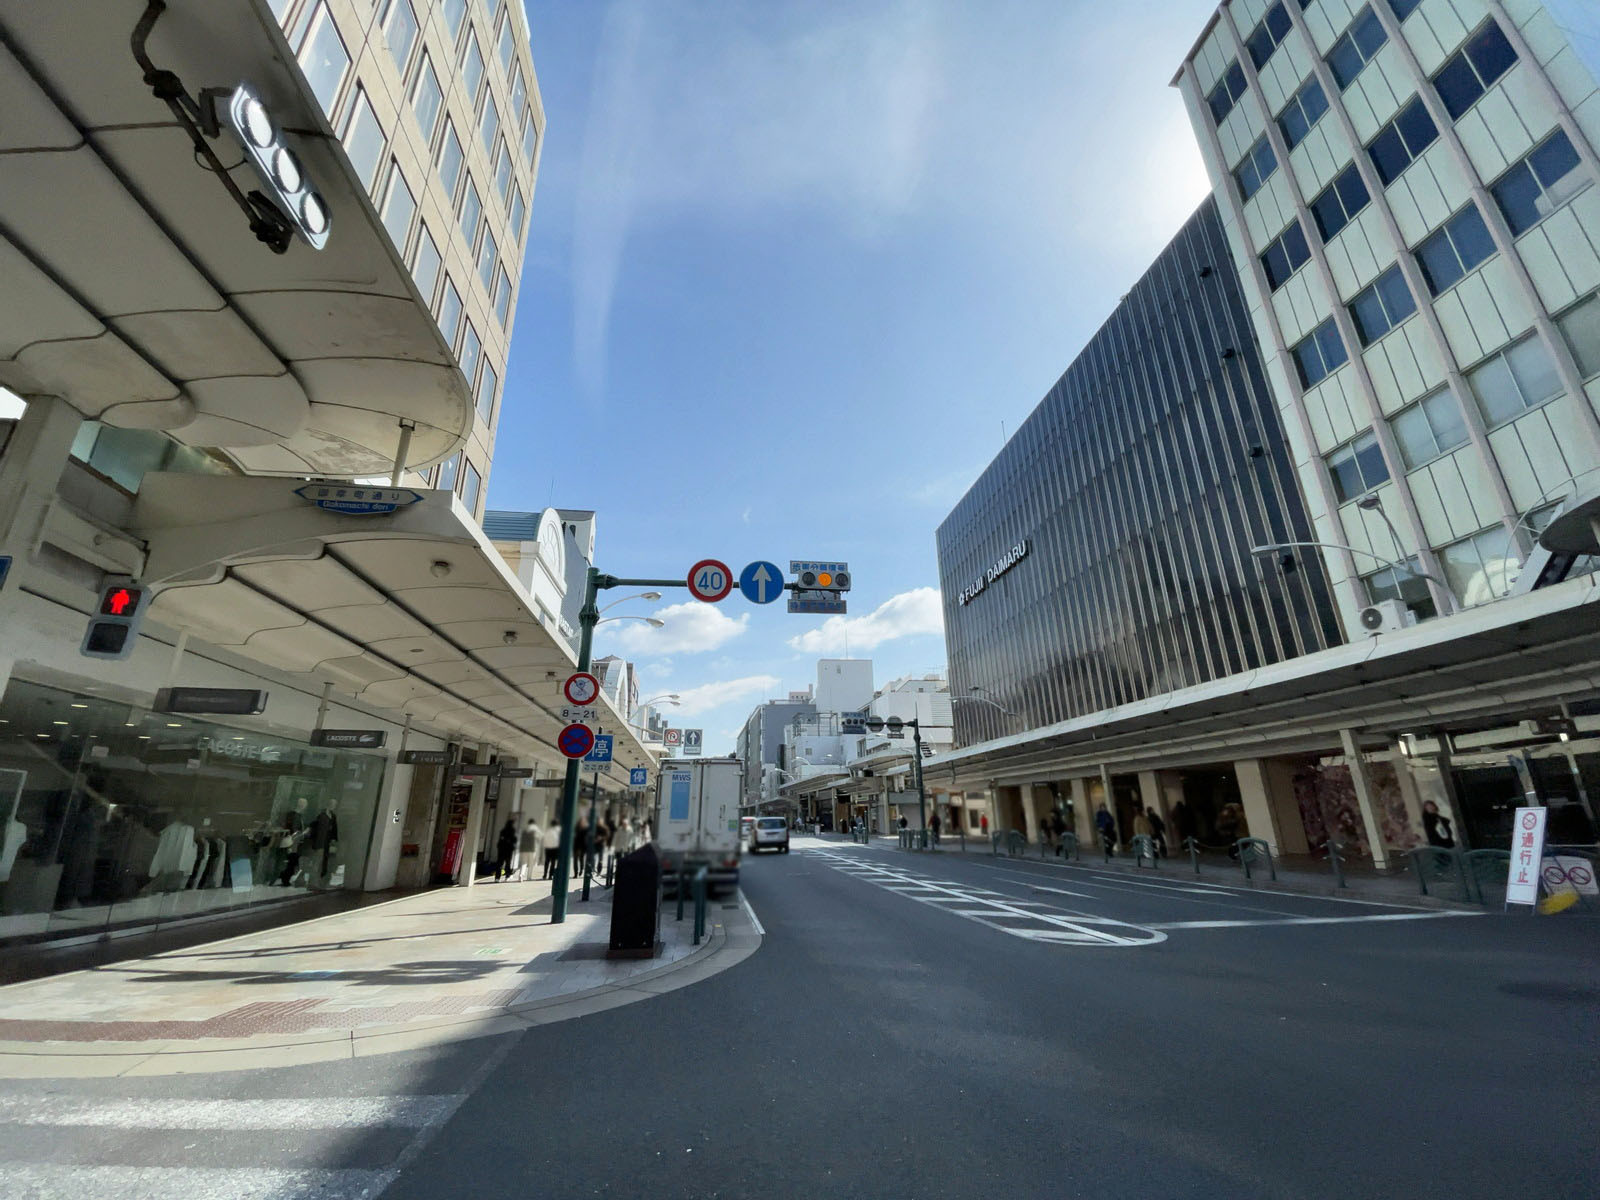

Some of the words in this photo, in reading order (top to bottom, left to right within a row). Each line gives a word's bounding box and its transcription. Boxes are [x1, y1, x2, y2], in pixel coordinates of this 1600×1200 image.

[987, 540, 1027, 583] DAIMARU
[698, 572, 722, 590] 40
[591, 739, 609, 758] 停
[672, 774, 691, 782] MWS
[1517, 832, 1534, 884] 通行止
